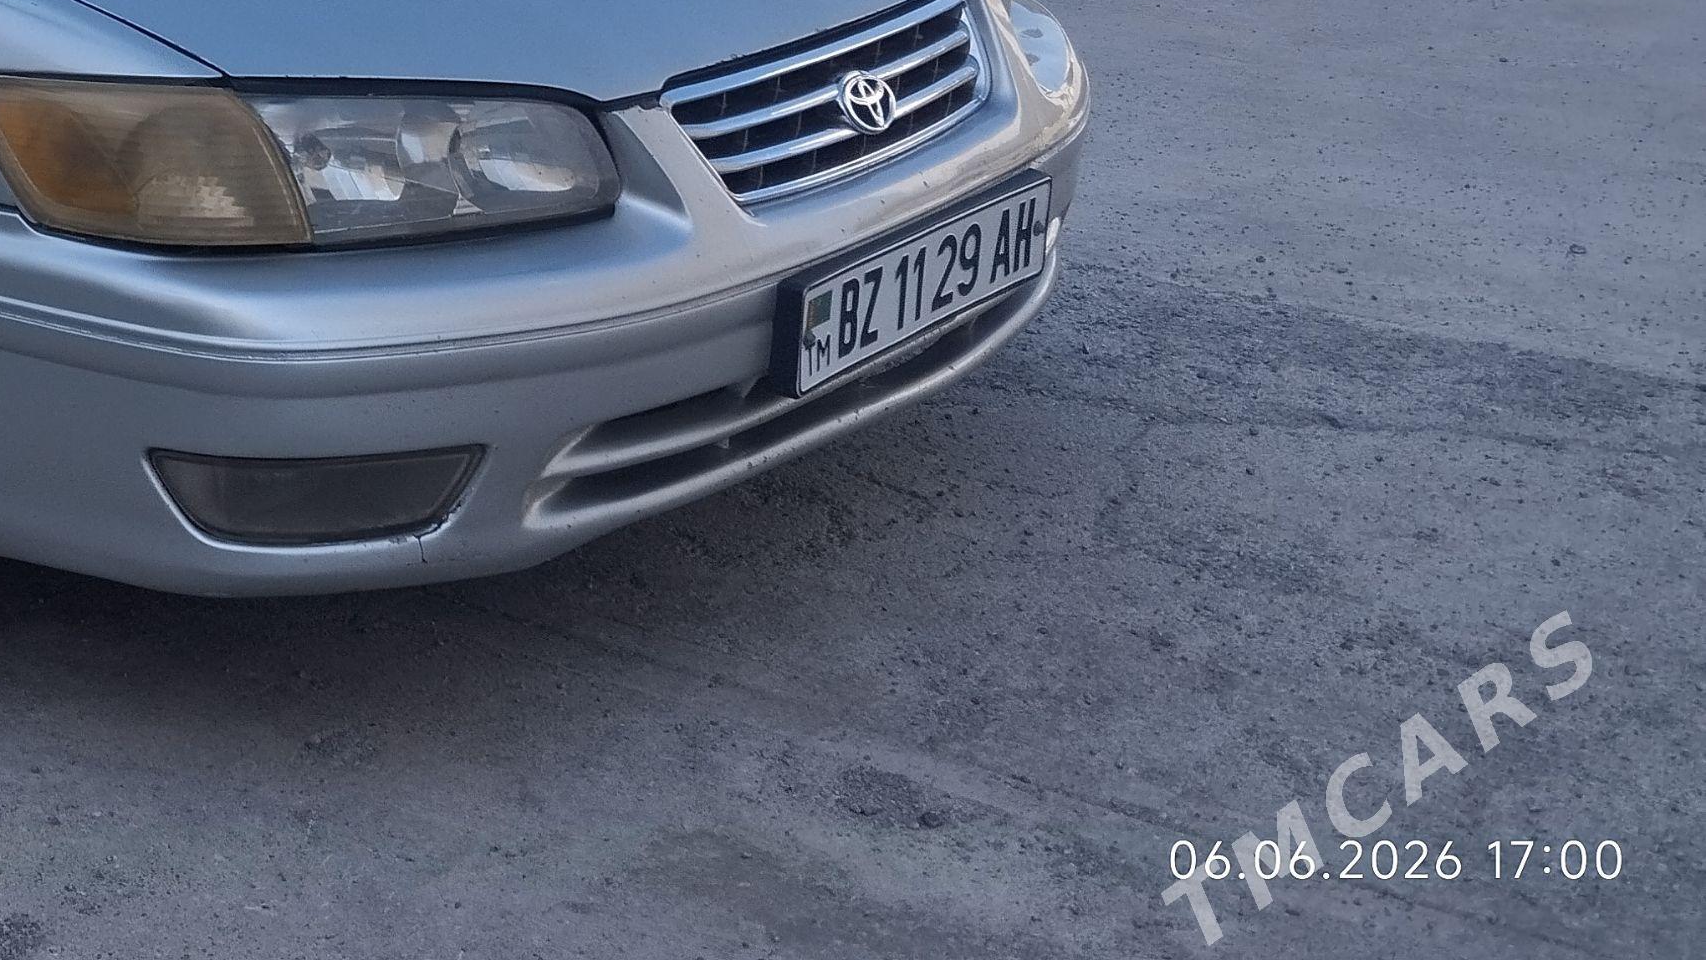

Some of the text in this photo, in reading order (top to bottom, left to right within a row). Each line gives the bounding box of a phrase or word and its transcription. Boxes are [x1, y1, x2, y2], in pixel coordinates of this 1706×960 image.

[838, 265, 883, 359] BZ
[989, 197, 1036, 284] AH
[802, 334, 831, 377] TM
